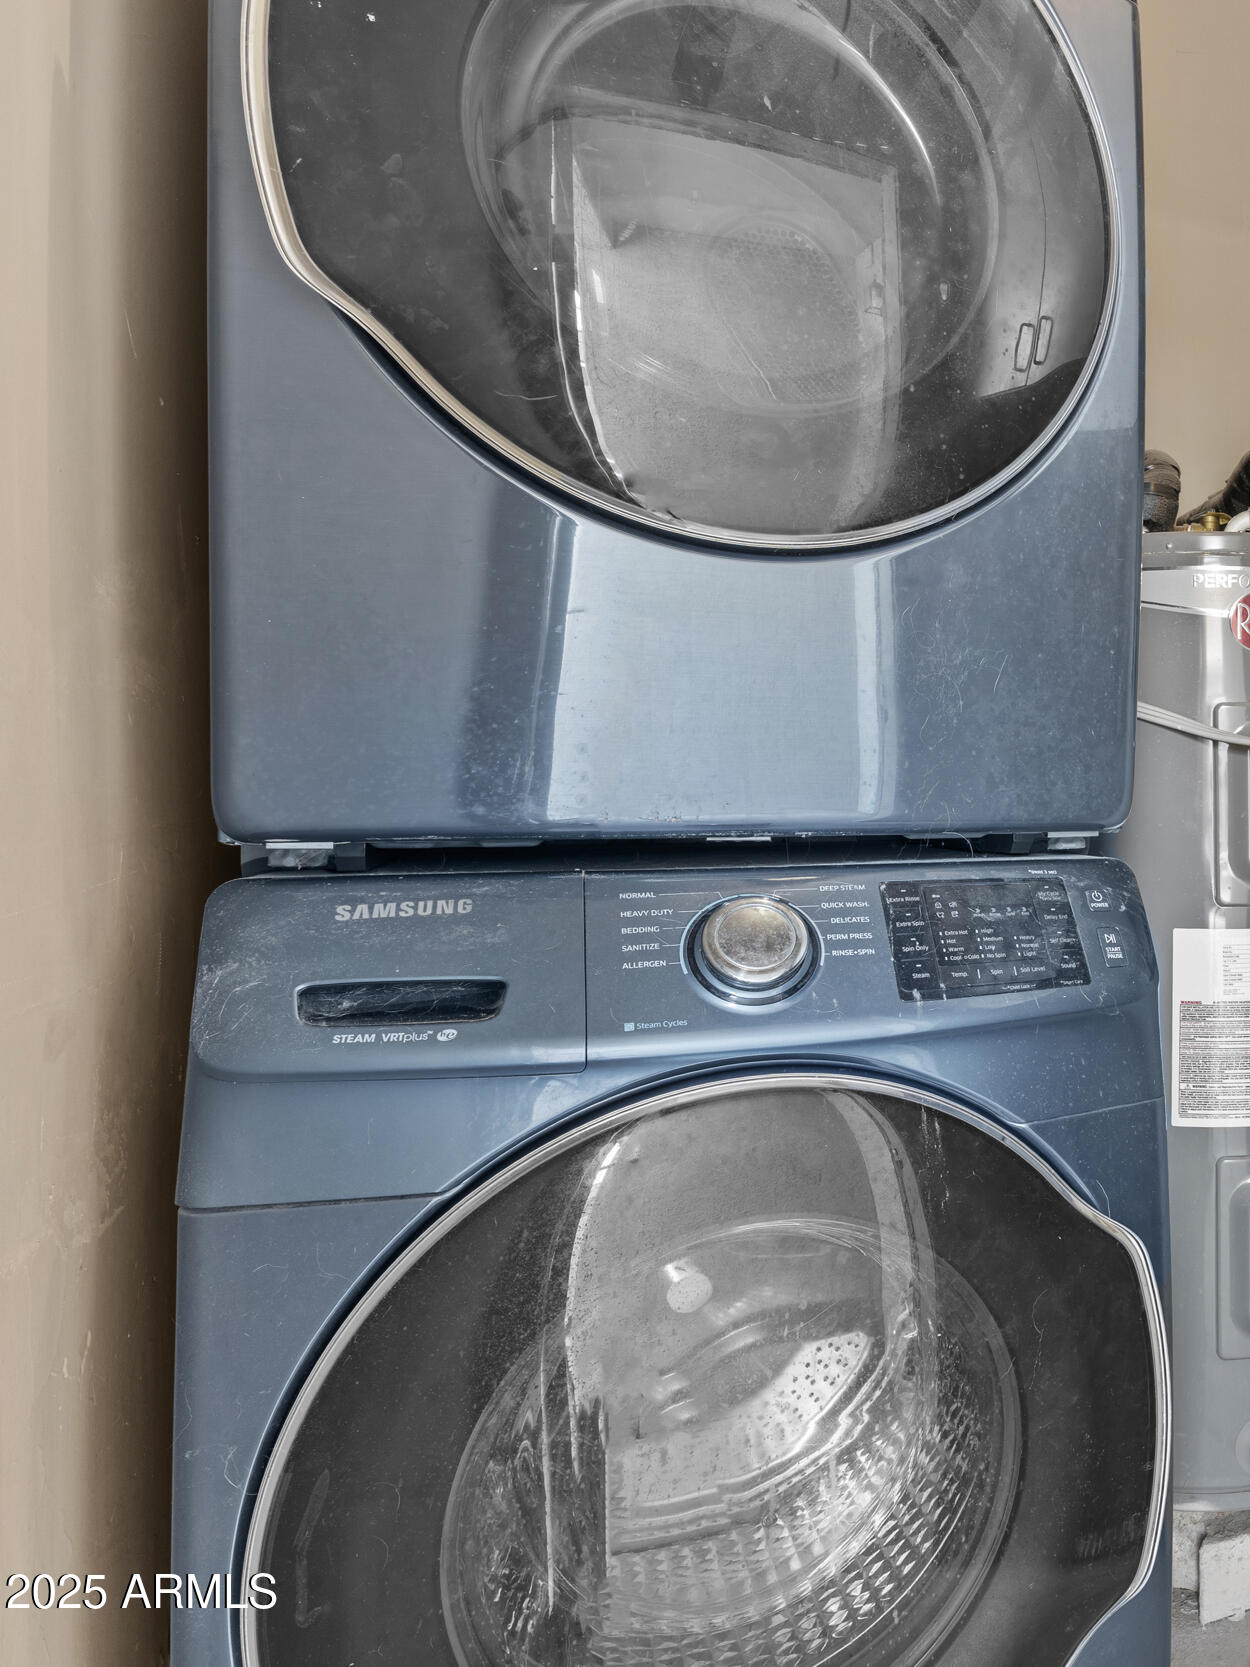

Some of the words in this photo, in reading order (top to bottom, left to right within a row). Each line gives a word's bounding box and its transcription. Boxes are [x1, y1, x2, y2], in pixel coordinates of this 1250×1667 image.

[619, 891, 657, 899] NORMAL
[334, 899, 473, 921] SAMSUNG
[650, 908, 674, 917] DUTY
[830, 916, 870, 924] DELICATES
[621, 926, 660, 935] BEDDING
[850, 932, 873, 940] PRESS
[622, 943, 660, 952] SANITIZE
[832, 948, 876, 956] RINSE+SPIN
[622, 960, 667, 969] ALLERGEN
[636, 1021, 662, 1031] Steam
[662, 1019, 688, 1030] Cycles
[332, 1033, 376, 1044] STEAM
